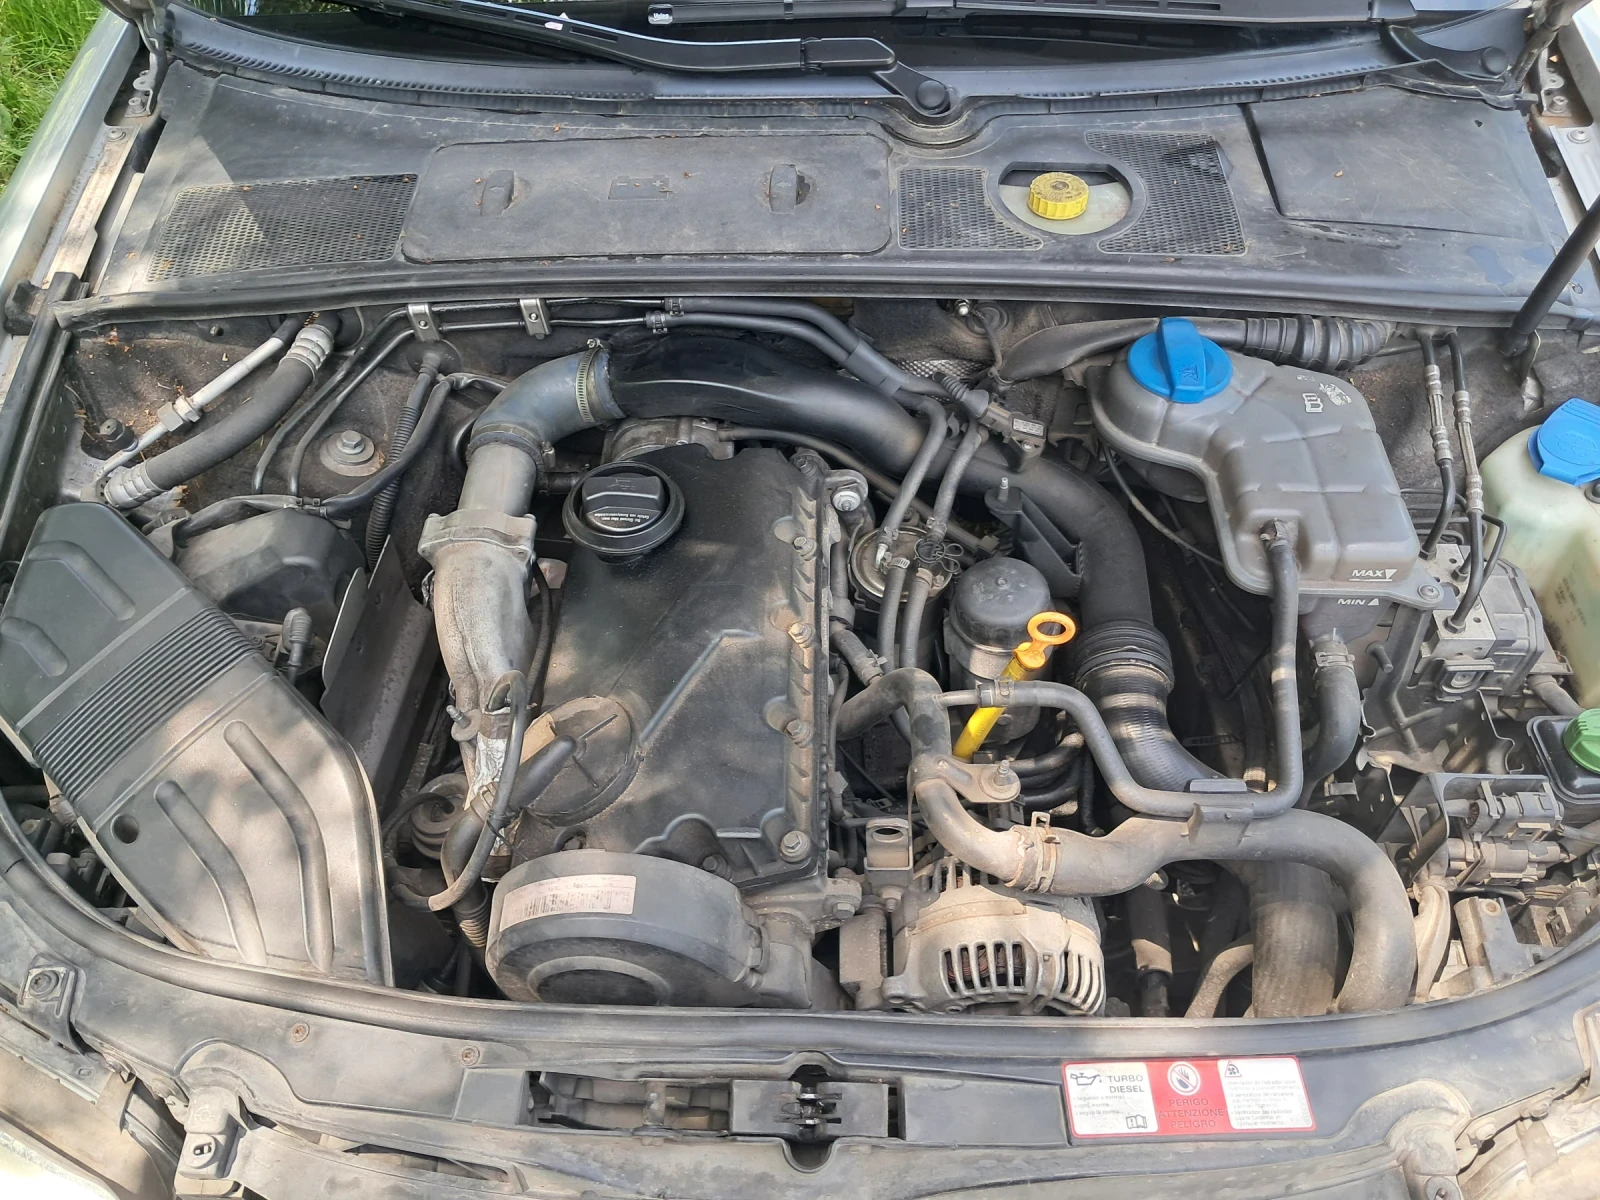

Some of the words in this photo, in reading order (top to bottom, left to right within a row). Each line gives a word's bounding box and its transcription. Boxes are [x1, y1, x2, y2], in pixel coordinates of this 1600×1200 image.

[1352, 569, 1384, 577] MAX
[1107, 1074, 1144, 1083] TURBO
[1109, 1085, 1145, 1093] DIESEL
[1168, 1098, 1209, 1107] PERIGO
[1158, 1108, 1224, 1118] ATTENZIONE
[1171, 1119, 1216, 1128] PELIGRO
